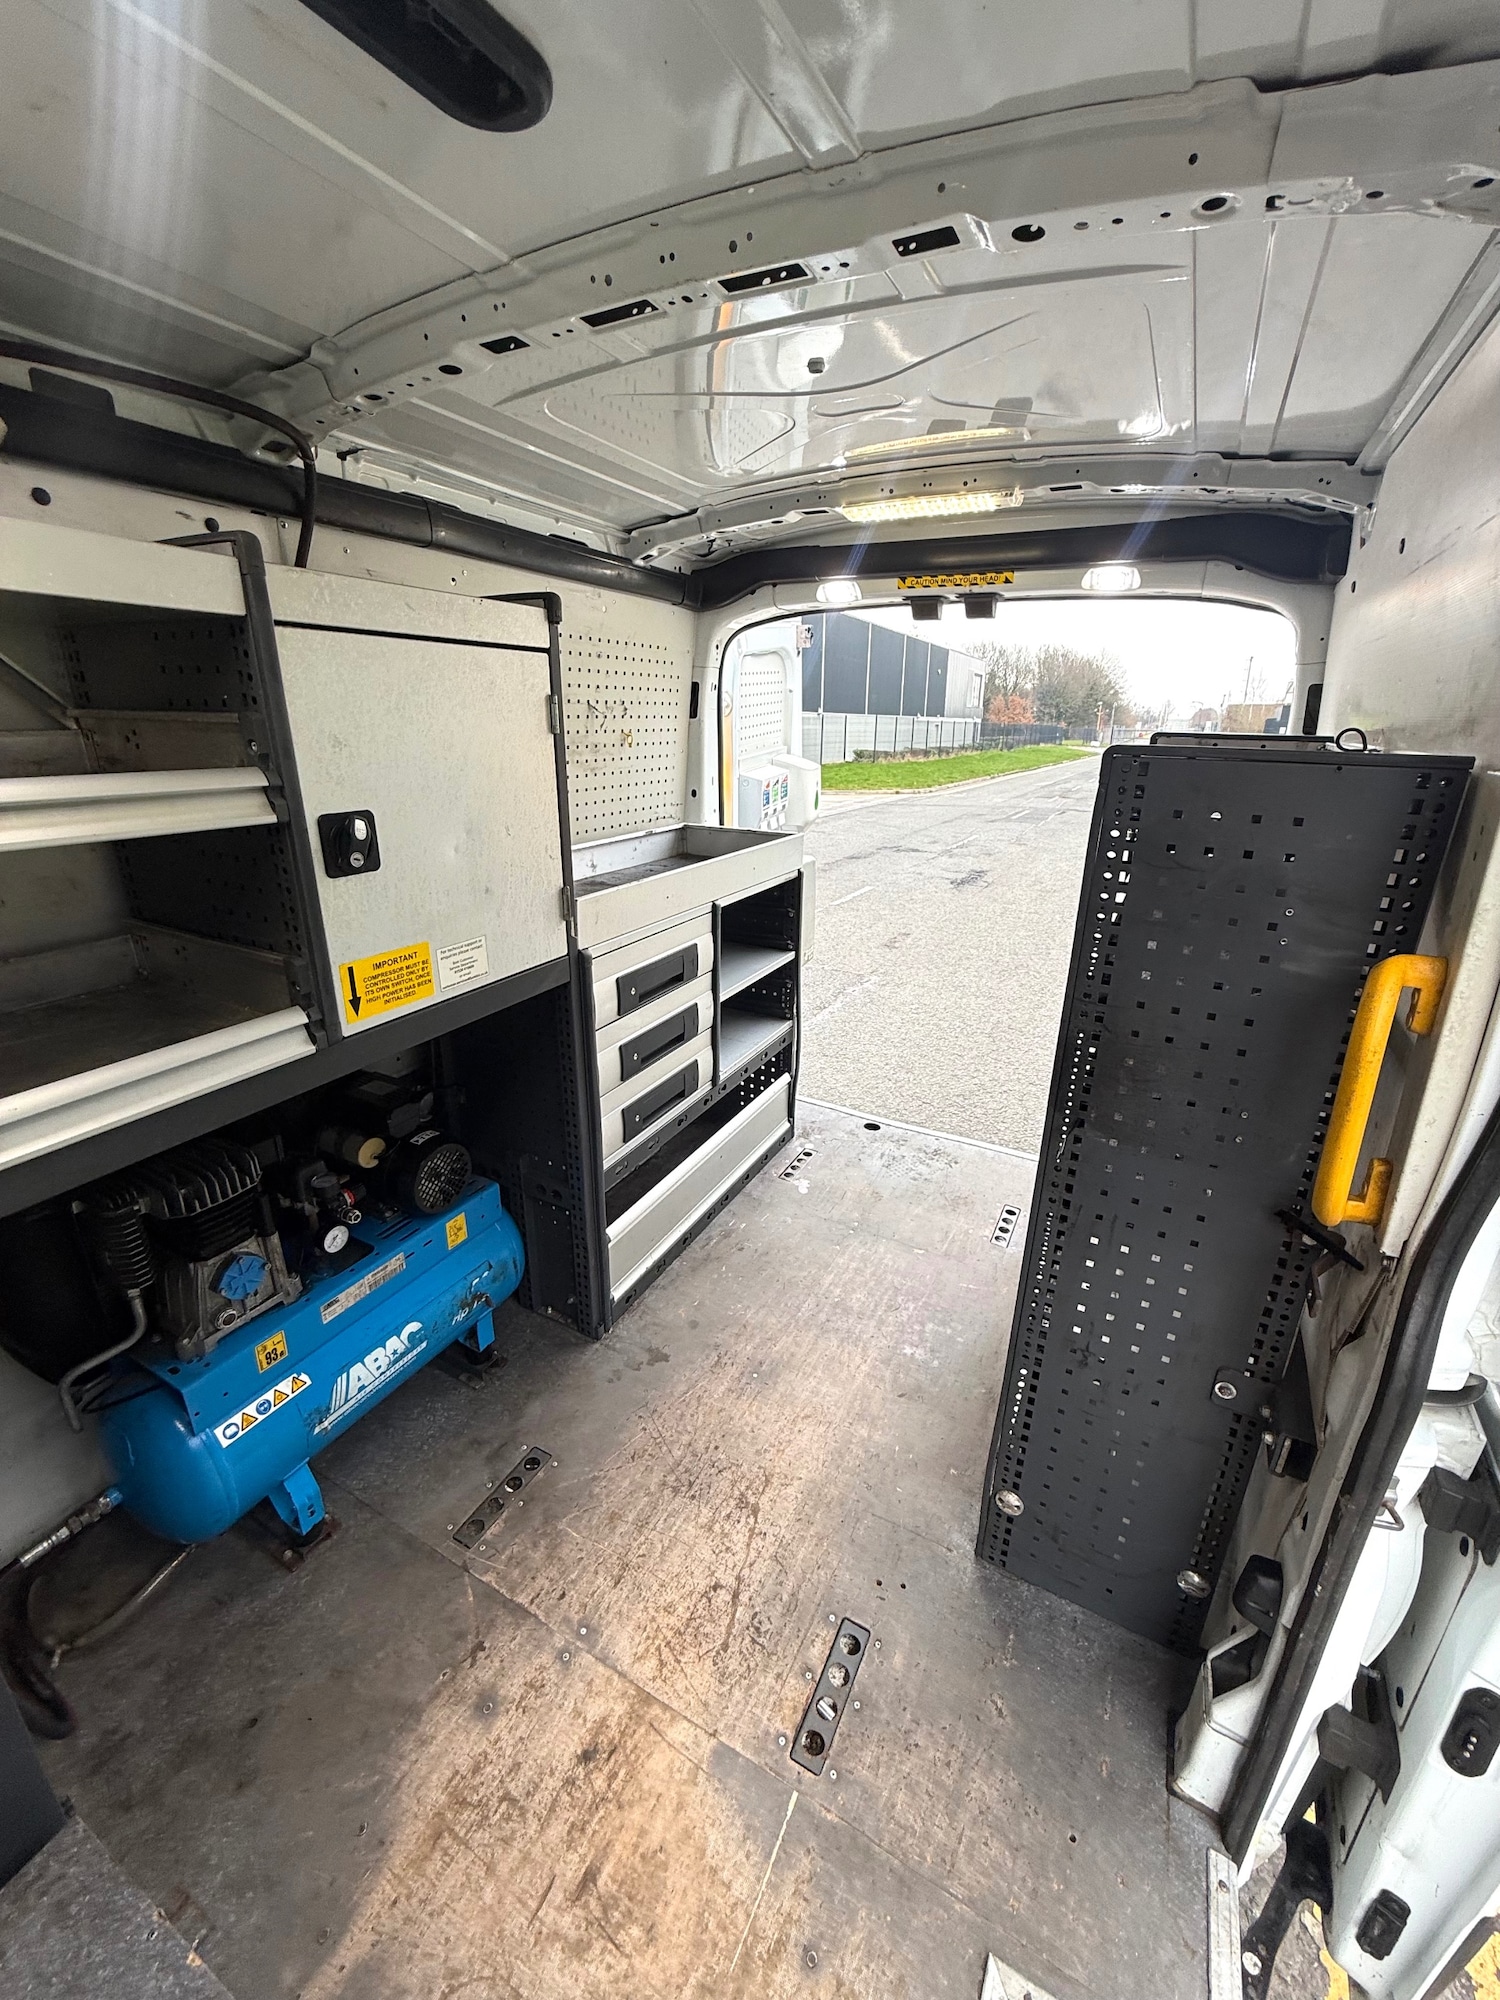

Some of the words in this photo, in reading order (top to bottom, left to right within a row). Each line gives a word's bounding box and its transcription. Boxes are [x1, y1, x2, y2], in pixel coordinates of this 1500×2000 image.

[911, 578, 939, 586] CAUTION
[940, 577, 957, 585] MIND
[959, 576, 978, 584] YOUR
[979, 575, 1001, 583] HEAD!
[363, 966, 405, 984] COMPRESSOR
[405, 961, 421, 970] MUST
[421, 958, 430, 966] BE
[372, 952, 417, 970] IMPORTANT
[365, 972, 405, 990] CONTROLLED
[405, 967, 421, 977] ONLY
[365, 989, 375, 997] ITS
[375, 984, 390, 993] OWN
[415, 972, 431, 981] ONCE
[366, 994, 382, 1004] HIGH
[382, 988, 404, 999] POWER
[404, 983, 416, 991] HAS
[417, 979, 432, 988] BEEN
[265, 1347, 279, 1366] 93
[347, 1321, 424, 1400] ABAC
